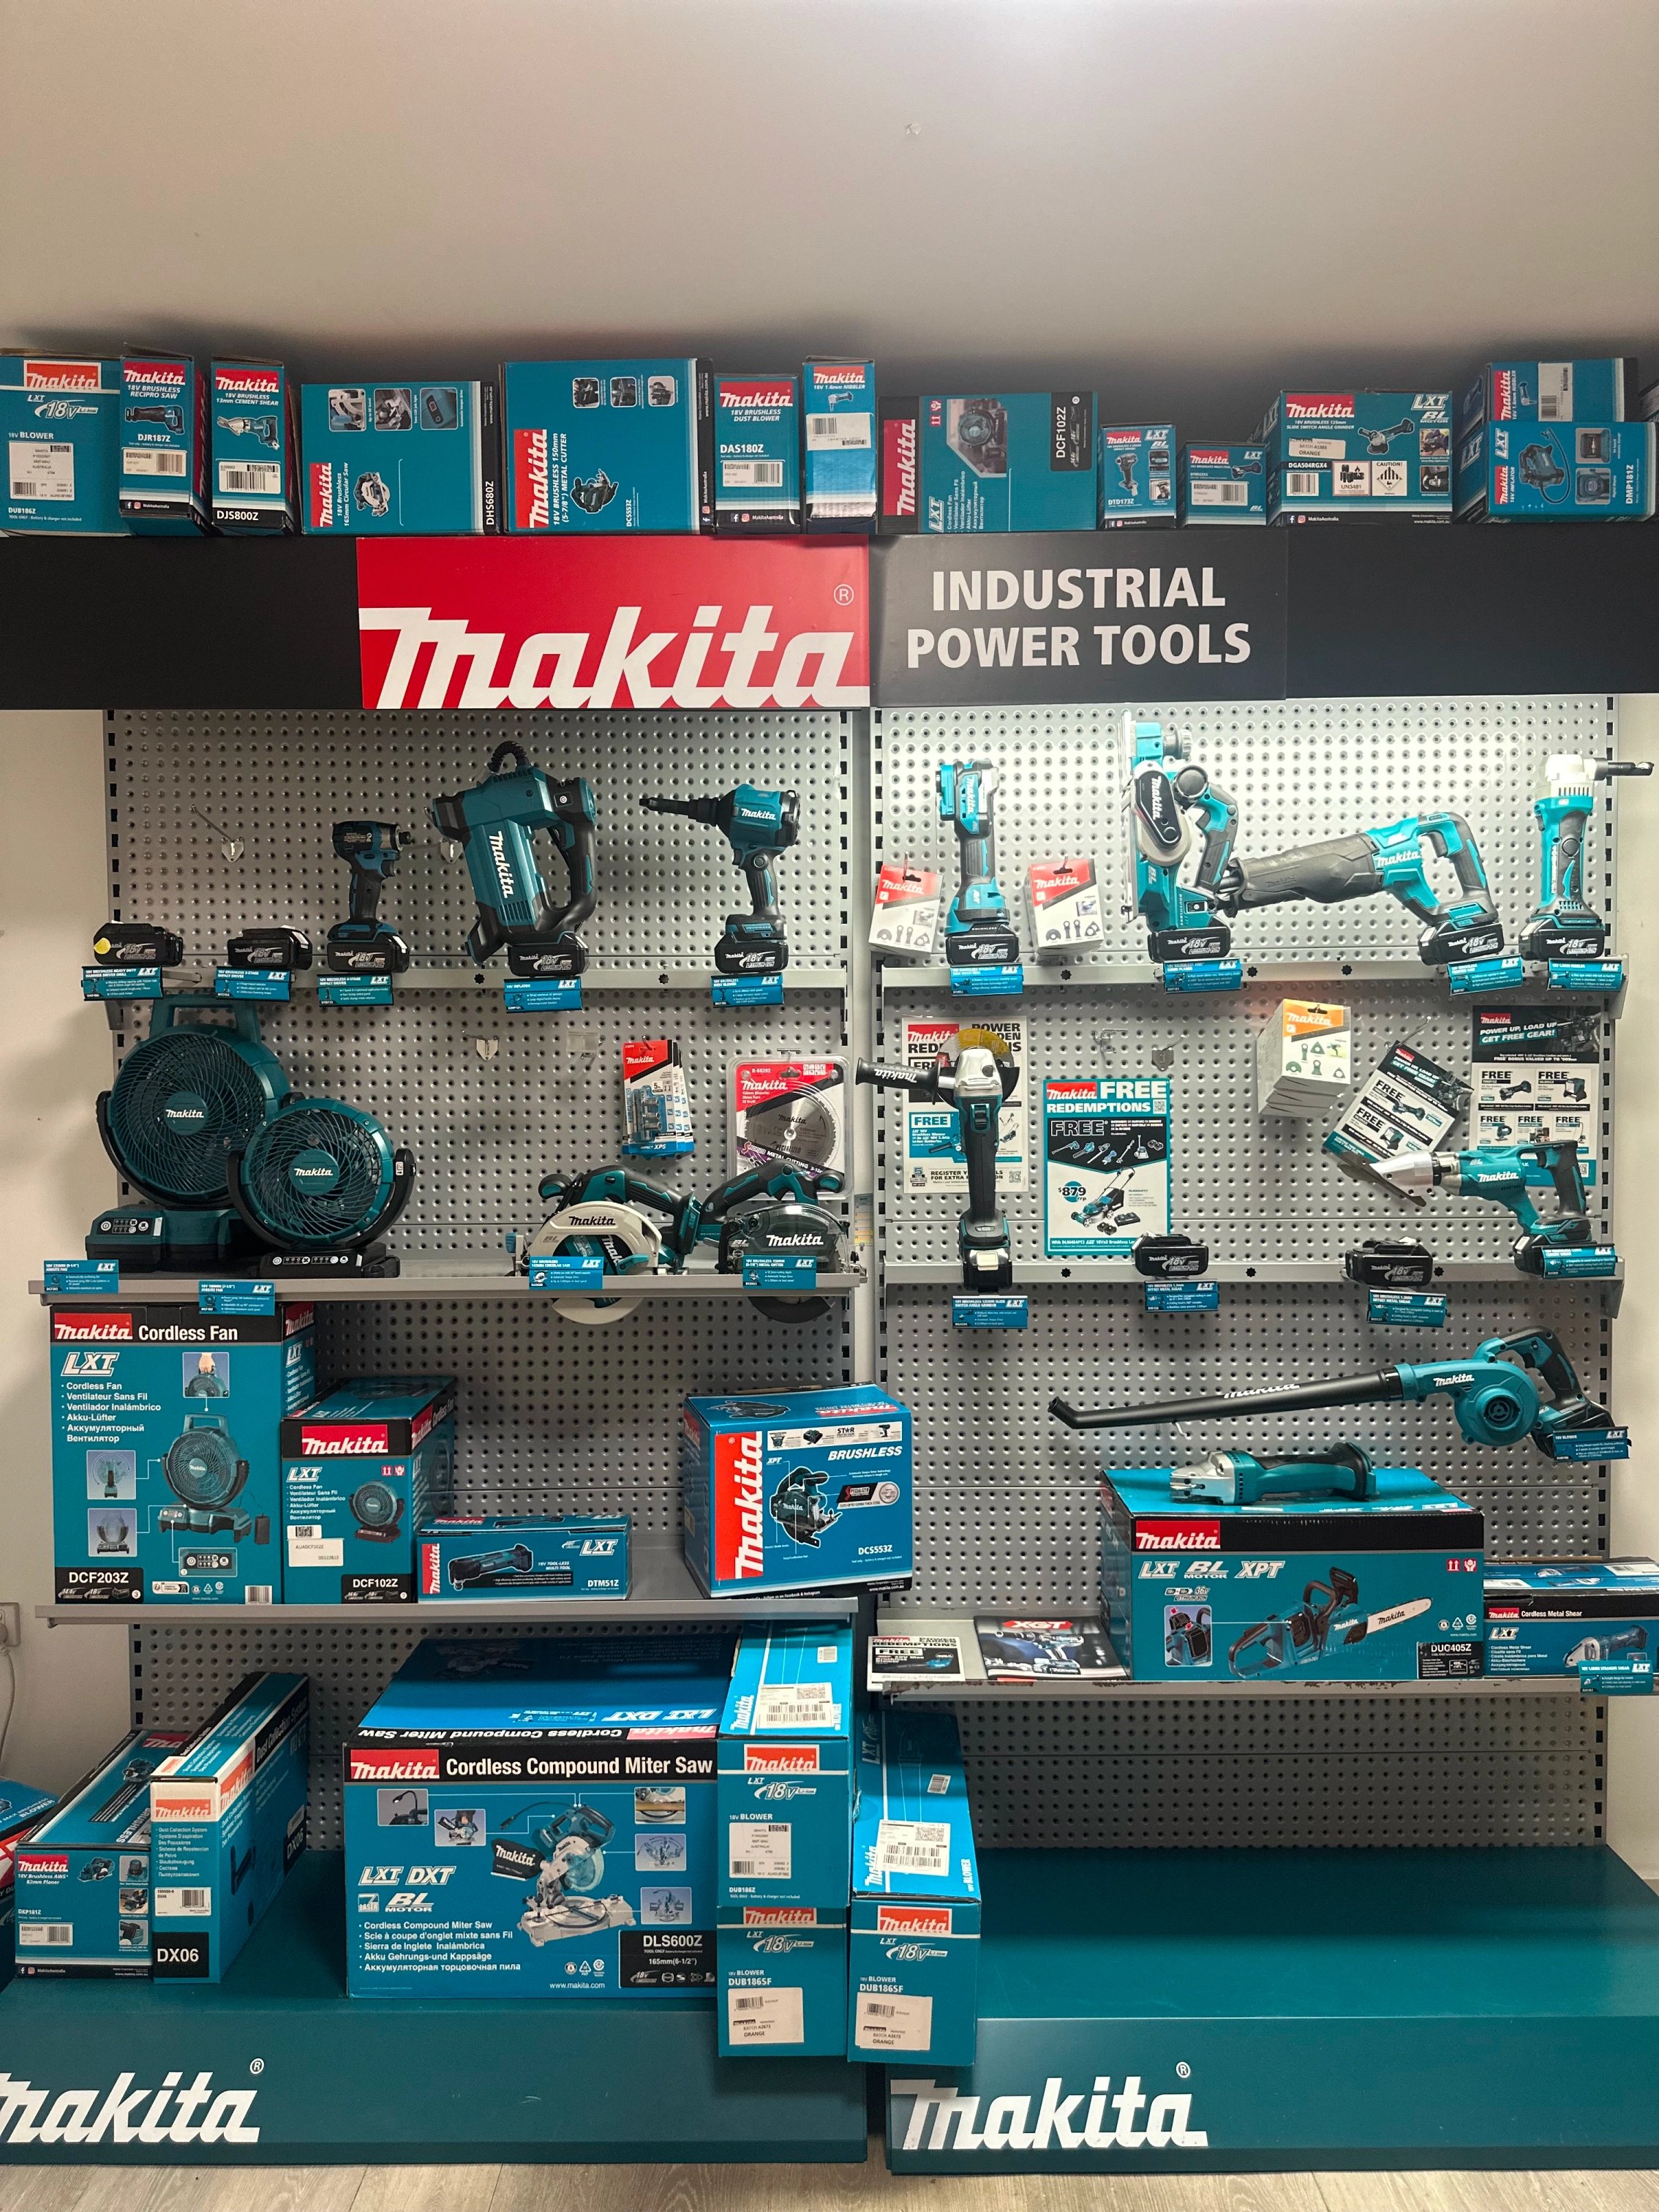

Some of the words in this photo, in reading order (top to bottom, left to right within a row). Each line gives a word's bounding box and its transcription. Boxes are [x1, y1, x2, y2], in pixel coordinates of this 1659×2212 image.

[1411, 394, 1449, 410] LXT
[138, 434, 170, 443] DJR187Z
[1056, 407, 1066, 458] DCF102Z
[720, 445, 764, 453] DAS180Z
[486, 481, 494, 525] DHS680Z
[217, 511, 259, 521] DJS800Z
[933, 568, 1226, 611] INDUSTRIAL
[907, 626, 1080, 669] POWER
[1094, 623, 1251, 665] TOOLS
[1480, 1027, 1508, 1035] POWER
[1527, 1030, 1555, 1038] GEAR!
[1100, 1081, 1167, 1099] FREE
[1047, 1102, 1151, 1113] REDEMPTIONS
[915, 1116, 948, 1125] FREE
[1051, 1121, 1104, 1136] FREE
[139, 1325, 205, 1340] Cordless
[211, 1326, 238, 1340] Fan
[61, 1353, 119, 1376] LXT
[67, 1425, 144, 1433] Аккумуляторный
[828, 1446, 902, 1461] BRUSHLESS
[286, 1467, 323, 1482] LXT
[579, 1540, 618, 1556] LXT
[858, 1545, 892, 1555] DCS553Z
[1138, 1562, 1180, 1579] LXT
[1235, 1561, 1285, 1578] XPT
[69, 1572, 128, 1584] DCF203Z
[353, 1579, 398, 1588] DCF102Z
[1012, 1621, 1066, 1629] XGT
[1489, 1628, 1519, 1640] LXT
[446, 1758, 522, 1775] Cordless
[526, 1758, 620, 1775] Compound
[625, 1758, 670, 1773] Miter
[675, 1757, 712, 1773] Saw
[358, 1867, 404, 1886] LXT
[405, 1866, 456, 1885] DXT
[404, 1922, 449, 1930] Compound
[420, 1933, 453, 1941] d'onglet
[643, 1935, 702, 1948] DLS600Z
[405, 1943, 432, 1951] Inglete
[157, 1949, 198, 1962] DX06
[388, 1953, 448, 1962] Gehrungs-und
[451, 1953, 492, 1961] Kappsäge
[365, 1964, 437, 1972] Аккумуляторная
[860, 1984, 903, 1993] DUB186SF
